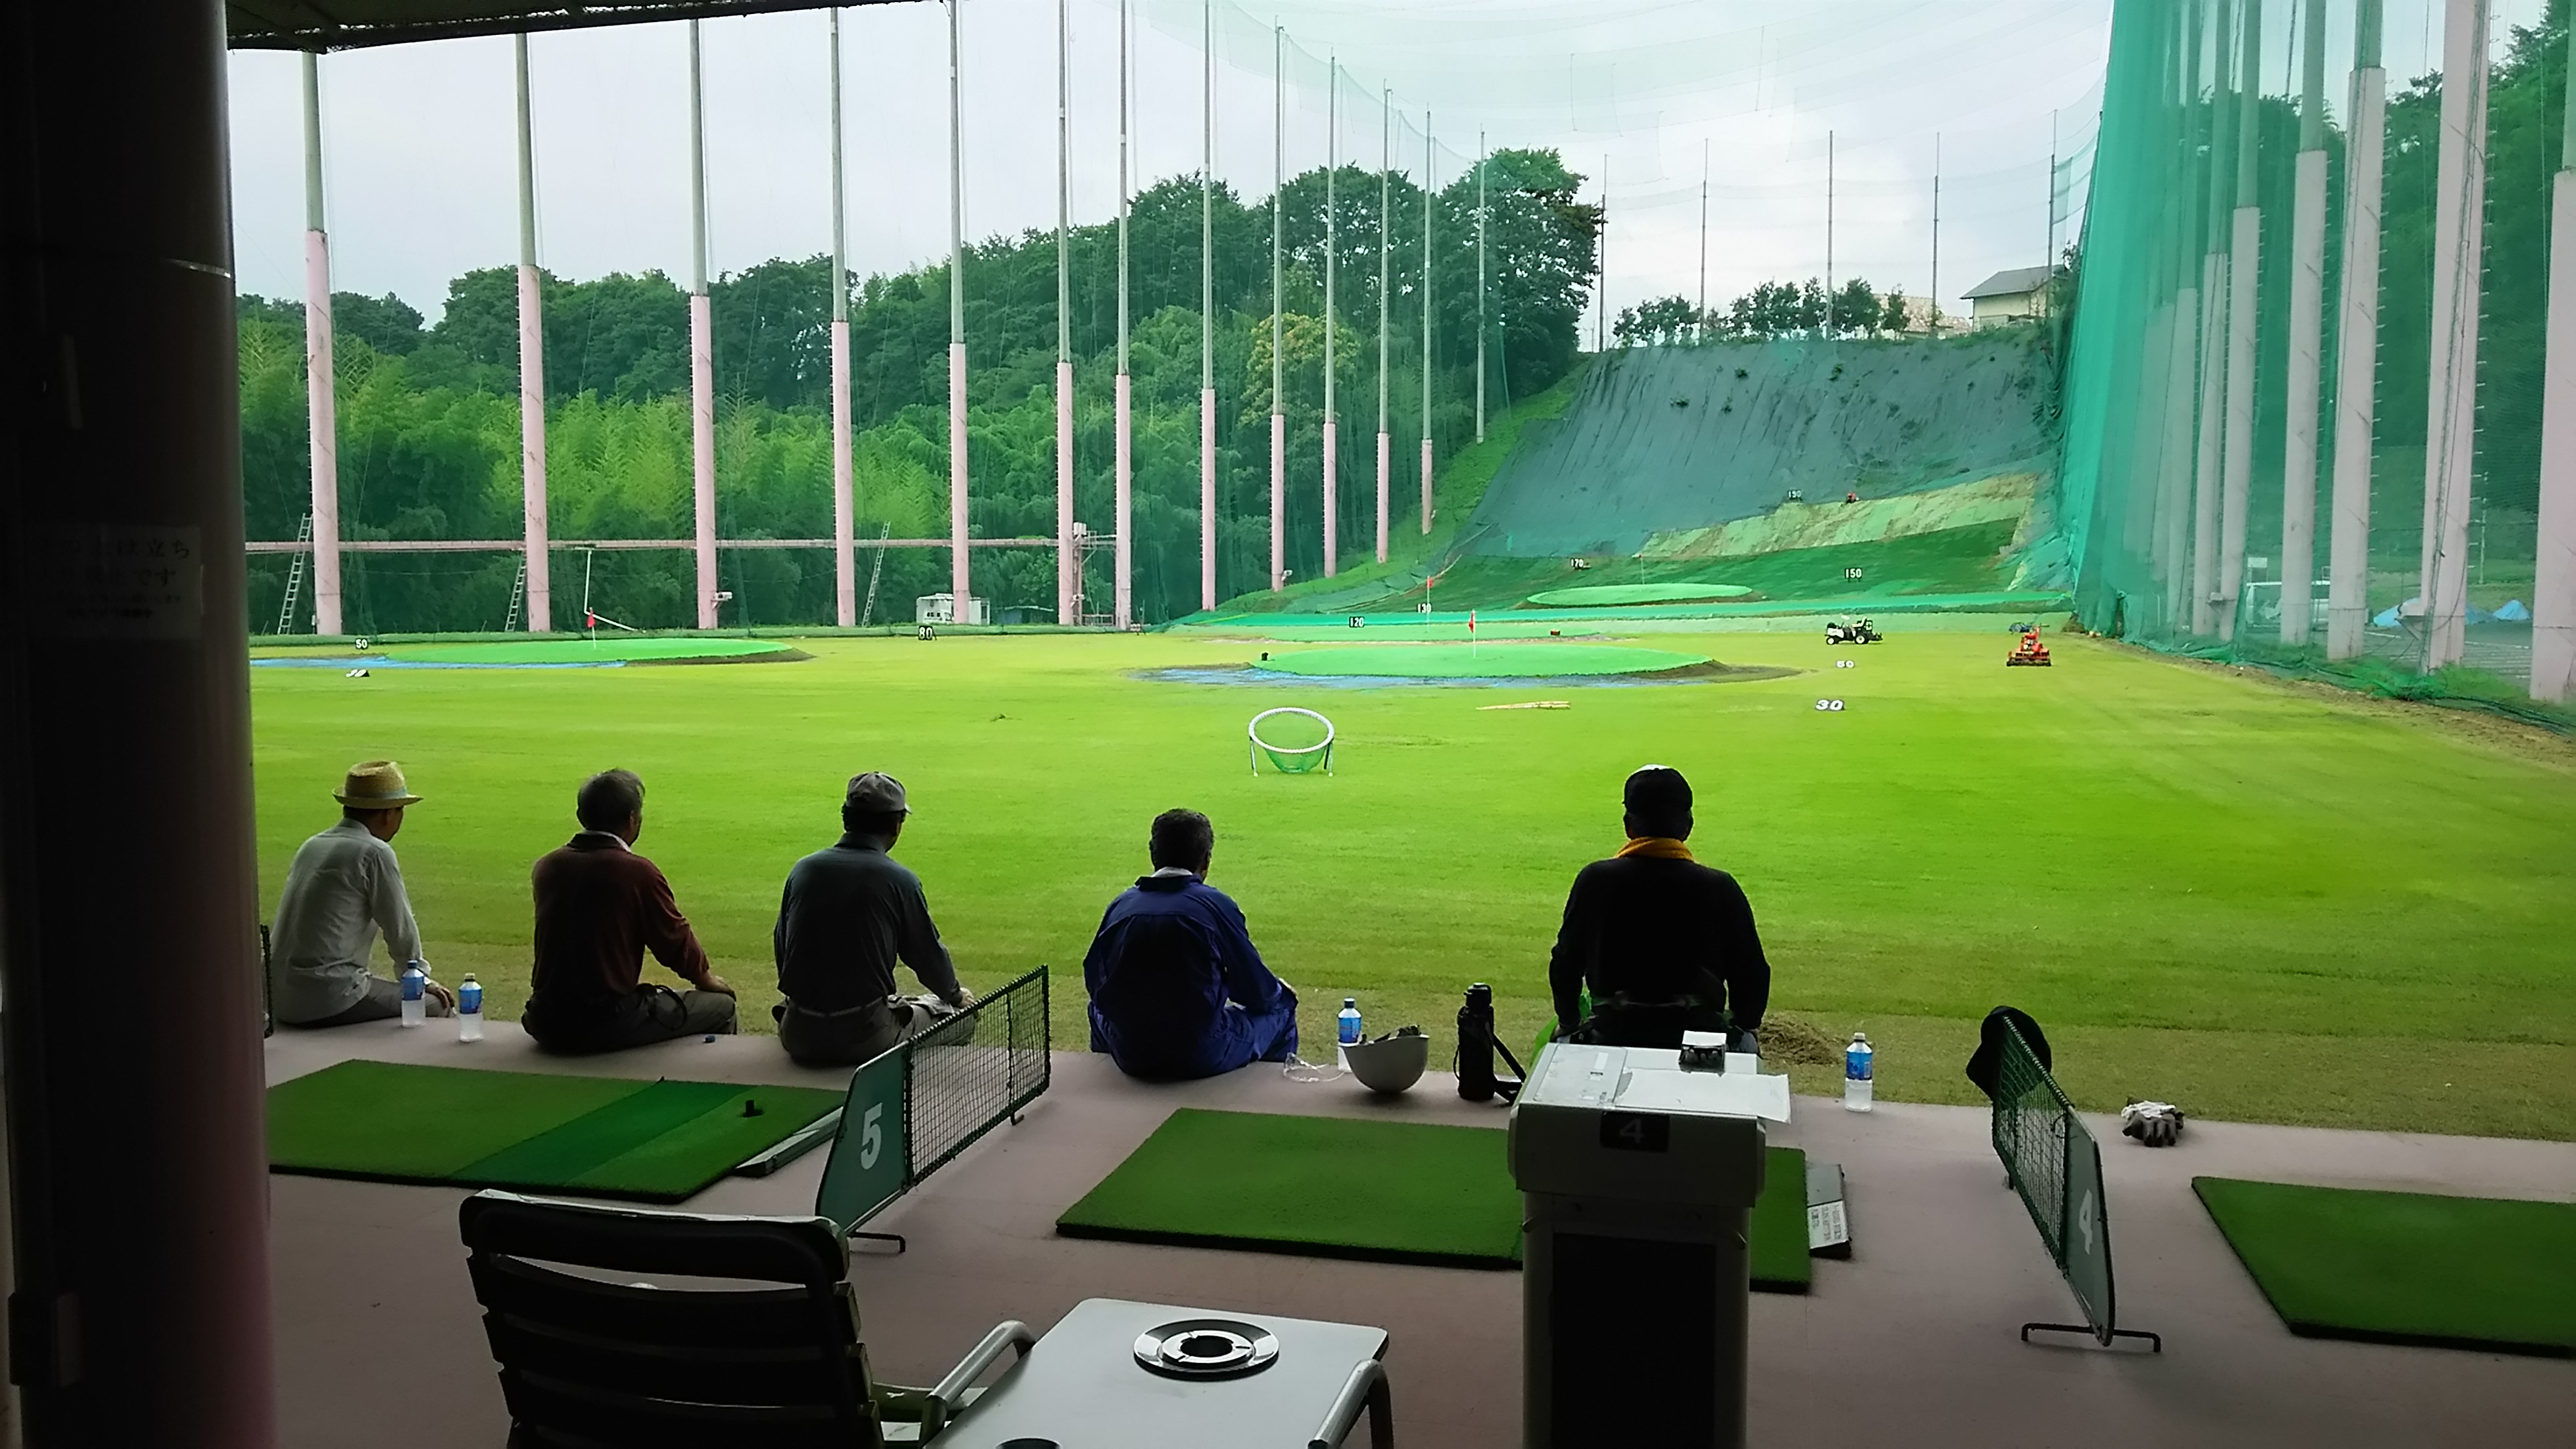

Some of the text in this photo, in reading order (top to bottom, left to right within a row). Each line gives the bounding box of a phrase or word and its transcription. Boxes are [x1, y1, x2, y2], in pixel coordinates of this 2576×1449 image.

[1571, 558, 1584, 568] 170
[1845, 568, 1862, 578] 150
[1417, 603, 1432, 613] 130
[1350, 617, 1364, 627] 120
[919, 627, 932, 639] 80
[356, 639, 368, 649] 50
[1815, 699, 1843, 710] 30
[1619, 1118, 1645, 1143] 4
[861, 1102, 883, 1170] 5
[2078, 1188, 2092, 1255] 4
